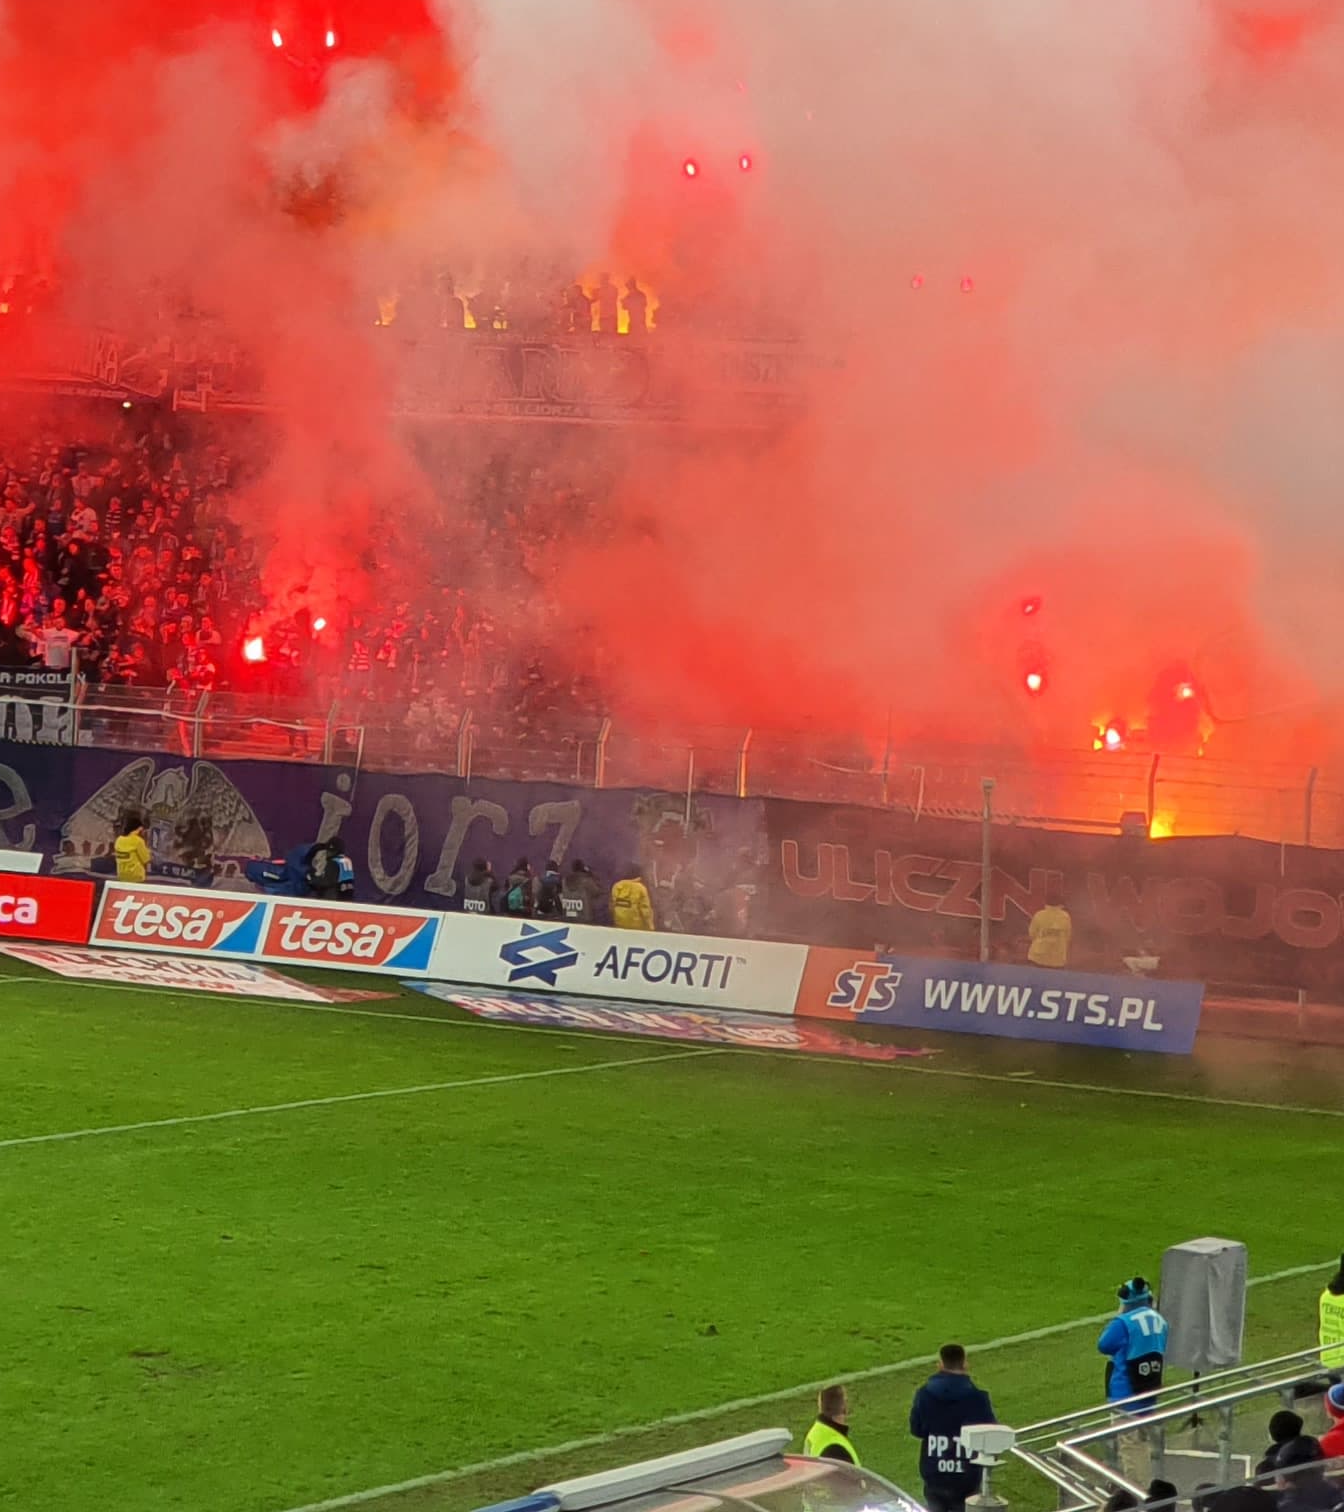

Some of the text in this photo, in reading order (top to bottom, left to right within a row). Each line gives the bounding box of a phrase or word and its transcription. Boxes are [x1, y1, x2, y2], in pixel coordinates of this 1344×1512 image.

[112, 894, 214, 942] tesa
[463, 898, 486, 912] FOTO
[278, 911, 384, 959] tesa
[593, 944, 732, 990] AFORTI
[827, 961, 903, 1012] STS
[924, 977, 1164, 1032] WWW.STS.PL
[927, 1434, 949, 1457] PP
[937, 1459, 964, 1474] 001
